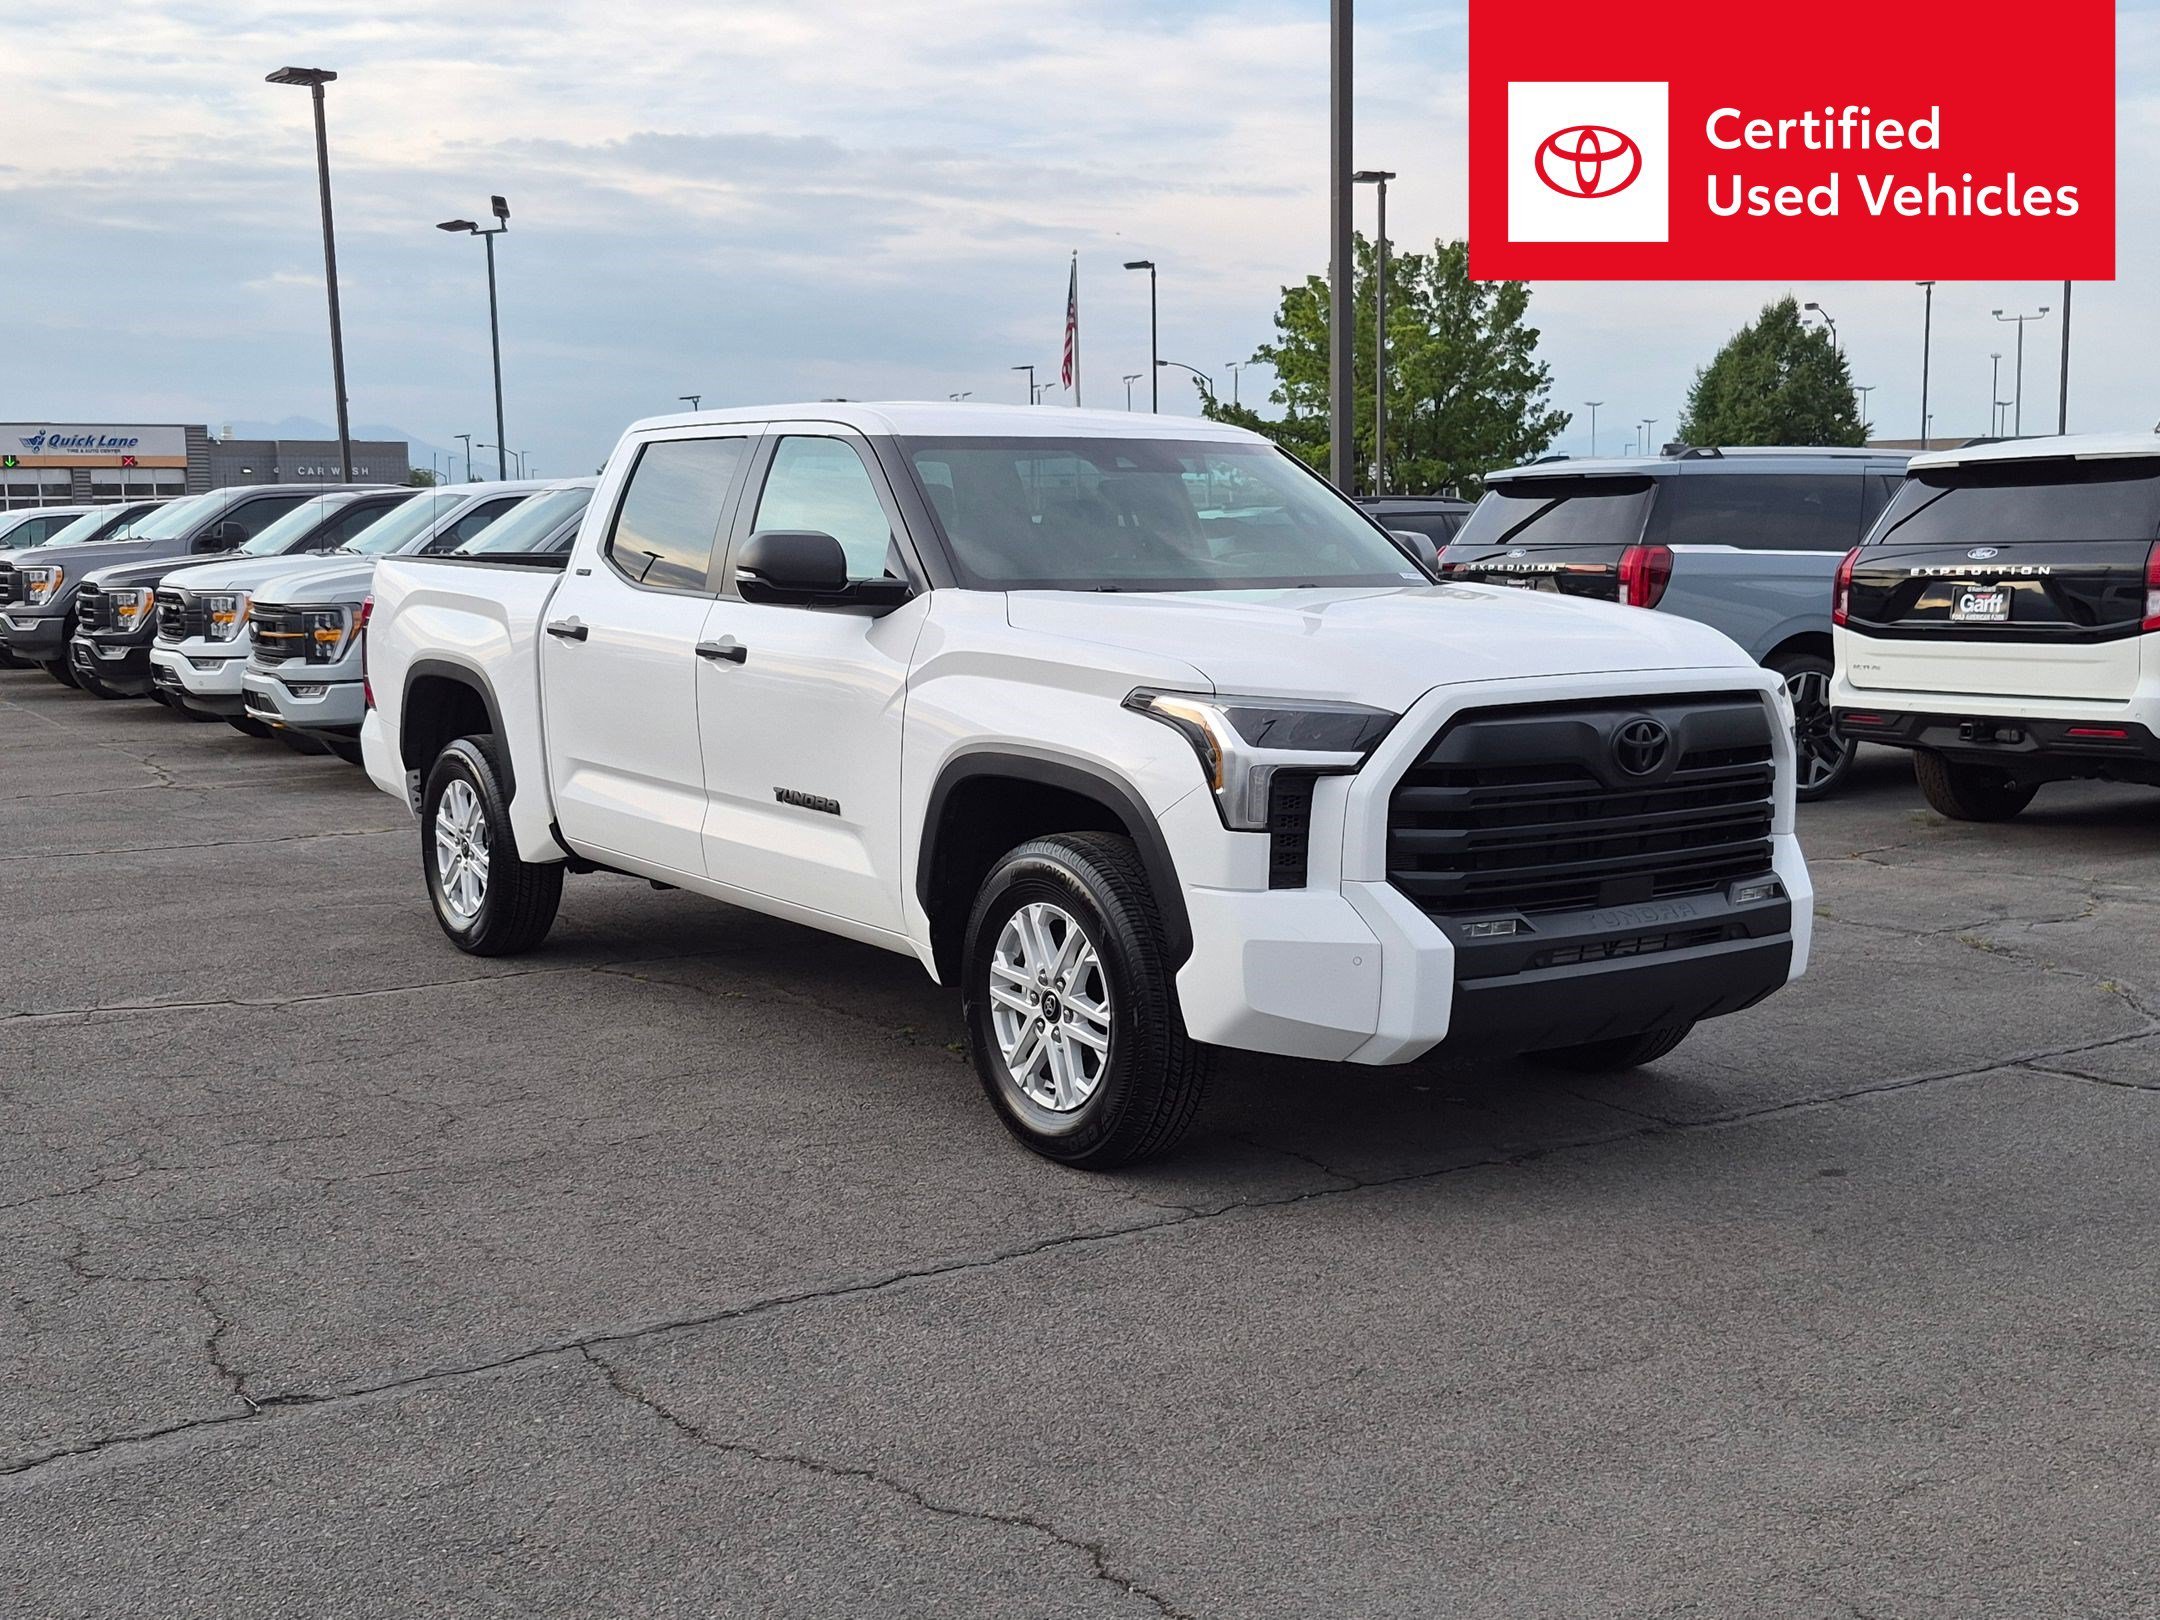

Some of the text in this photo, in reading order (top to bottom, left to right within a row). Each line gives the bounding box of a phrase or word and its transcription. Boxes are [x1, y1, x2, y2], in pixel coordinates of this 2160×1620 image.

[48, 434, 139, 448] Quick Lane
[297, 466, 369, 476] CAR WSH
[1470, 564, 1557, 572] EXPEDITION
[1910, 566, 2051, 577] EXPEDITION
[1960, 593, 2004, 613] Garff
[773, 786, 842, 816] TUNDRA
[1585, 900, 1698, 930] TUNDRA
